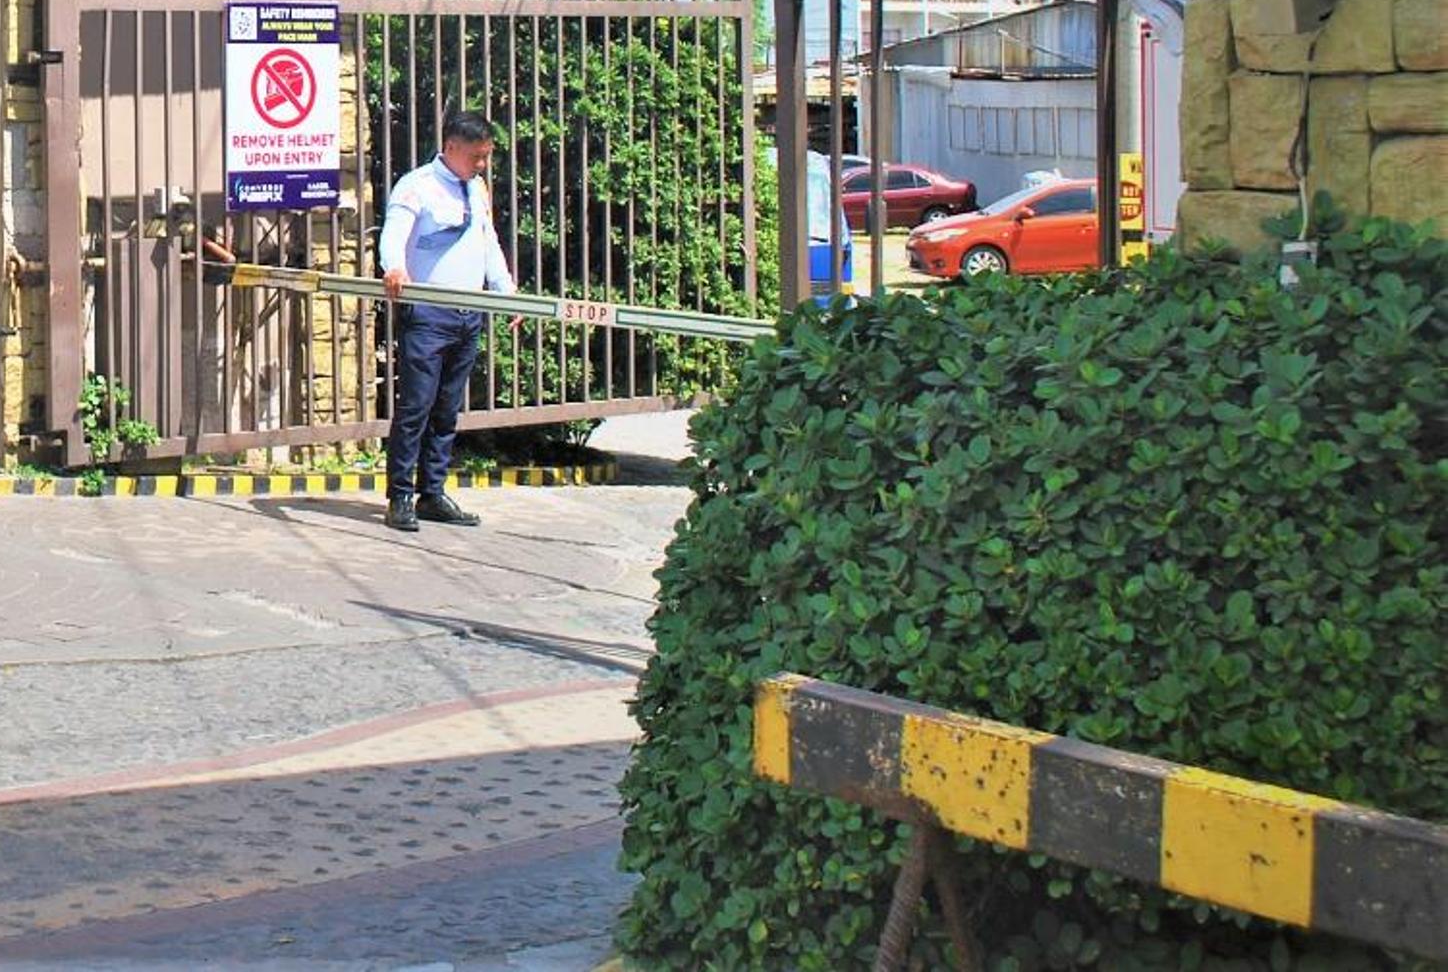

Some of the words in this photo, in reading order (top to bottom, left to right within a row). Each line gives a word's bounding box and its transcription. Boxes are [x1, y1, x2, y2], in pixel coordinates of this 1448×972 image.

[260, 7, 290, 19] SAFETY
[232, 134, 284, 148] REMOVE
[287, 133, 335, 147] HELMET
[245, 152, 281, 166] UPON
[284, 151, 323, 165] ENTRY
[565, 303, 607, 321] STOP
